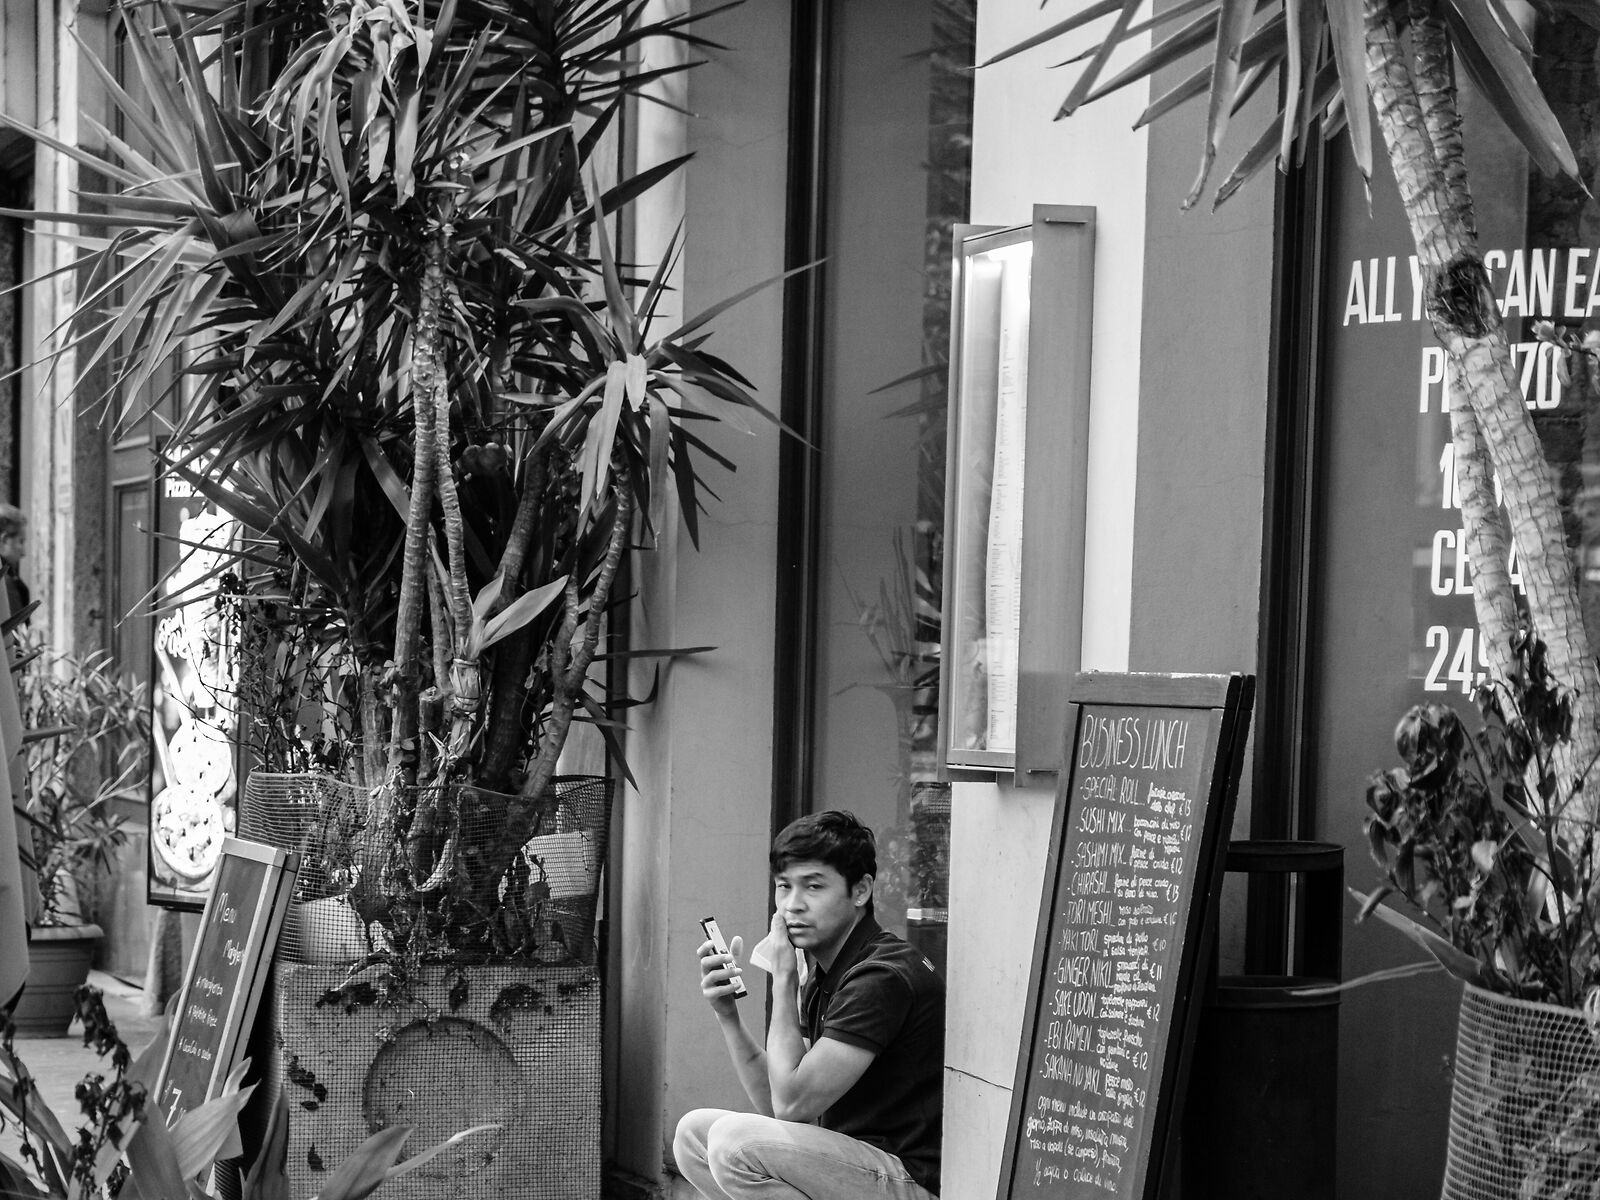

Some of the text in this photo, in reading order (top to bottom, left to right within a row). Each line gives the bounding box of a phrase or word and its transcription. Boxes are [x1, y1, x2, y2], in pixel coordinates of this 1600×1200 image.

[1343, 256, 1402, 326] ALL
[1431, 528, 1527, 596] CEA
[1080, 714, 1188, 770] BUSINESS LUNCH
[1083, 774, 1116, 801] SPECIAL
[1119, 776, 1139, 805] ROLL
[1079, 807, 1126, 833] SUSHI MIX
[1075, 842, 1125, 868] SASHIMI MIX
[1170, 857, 1183, 875] €12
[1071, 870, 1108, 896] CHIRASHI
[1166, 883, 1180, 903] €13
[1066, 898, 1113, 926] TORI MESHI
[1060, 928, 1099, 952] YAKI TORI
[1057, 956, 1091, 987] GINGER
[1149, 962, 1163, 981] €11
[1053, 989, 1097, 1018] SAKE UDON
[1047, 1020, 1093, 1051] EBI RAMEN
[1042, 1053, 1073, 1085] SAKANA
[1132, 1051, 1149, 1071] €12
